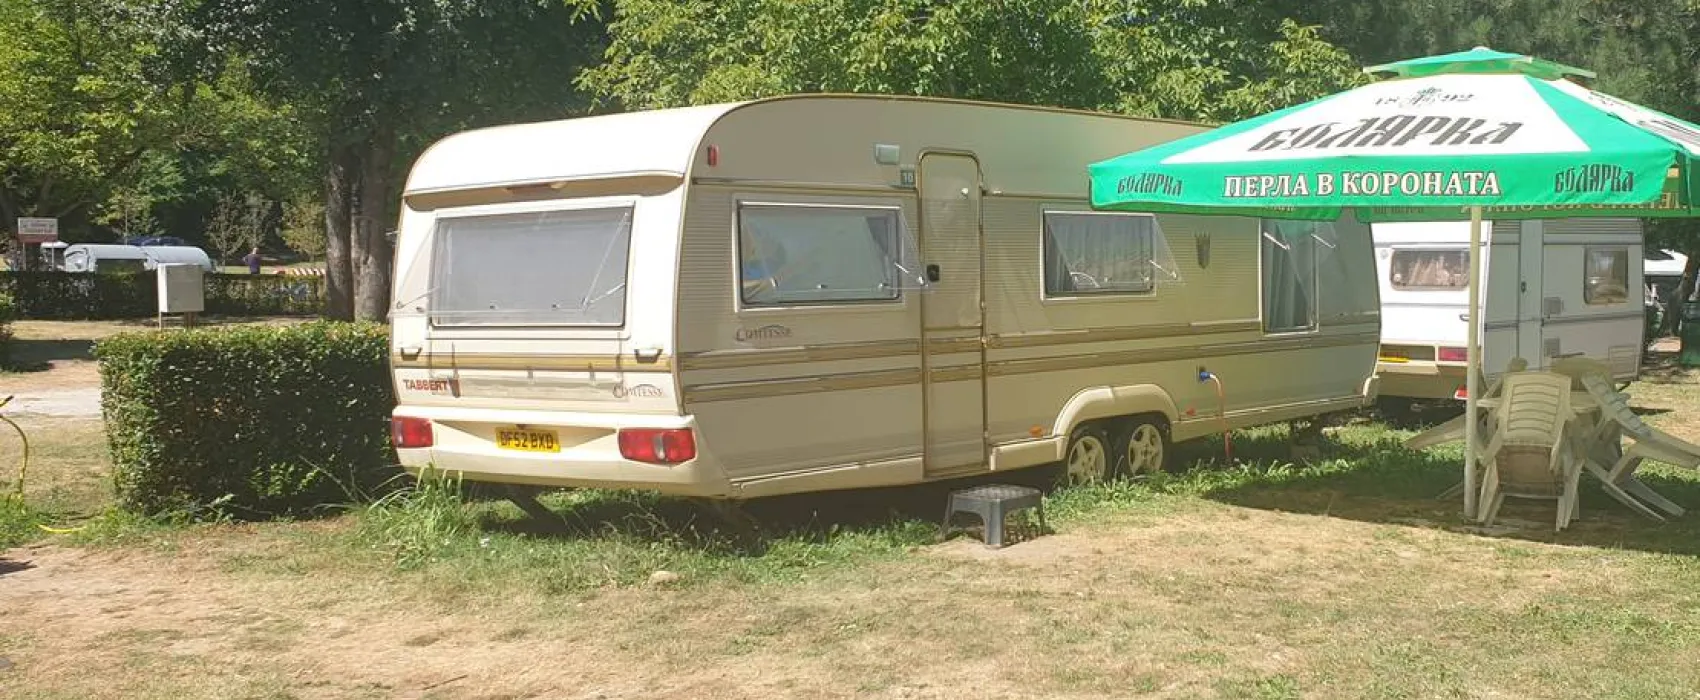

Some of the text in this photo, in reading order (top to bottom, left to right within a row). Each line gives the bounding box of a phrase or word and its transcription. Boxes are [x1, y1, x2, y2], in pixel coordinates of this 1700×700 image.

[1223, 170, 1502, 198] ПЕРЛА В КОРОНАТА
[402, 379, 448, 391] TABBERT
[530, 432, 554, 450] BXD
